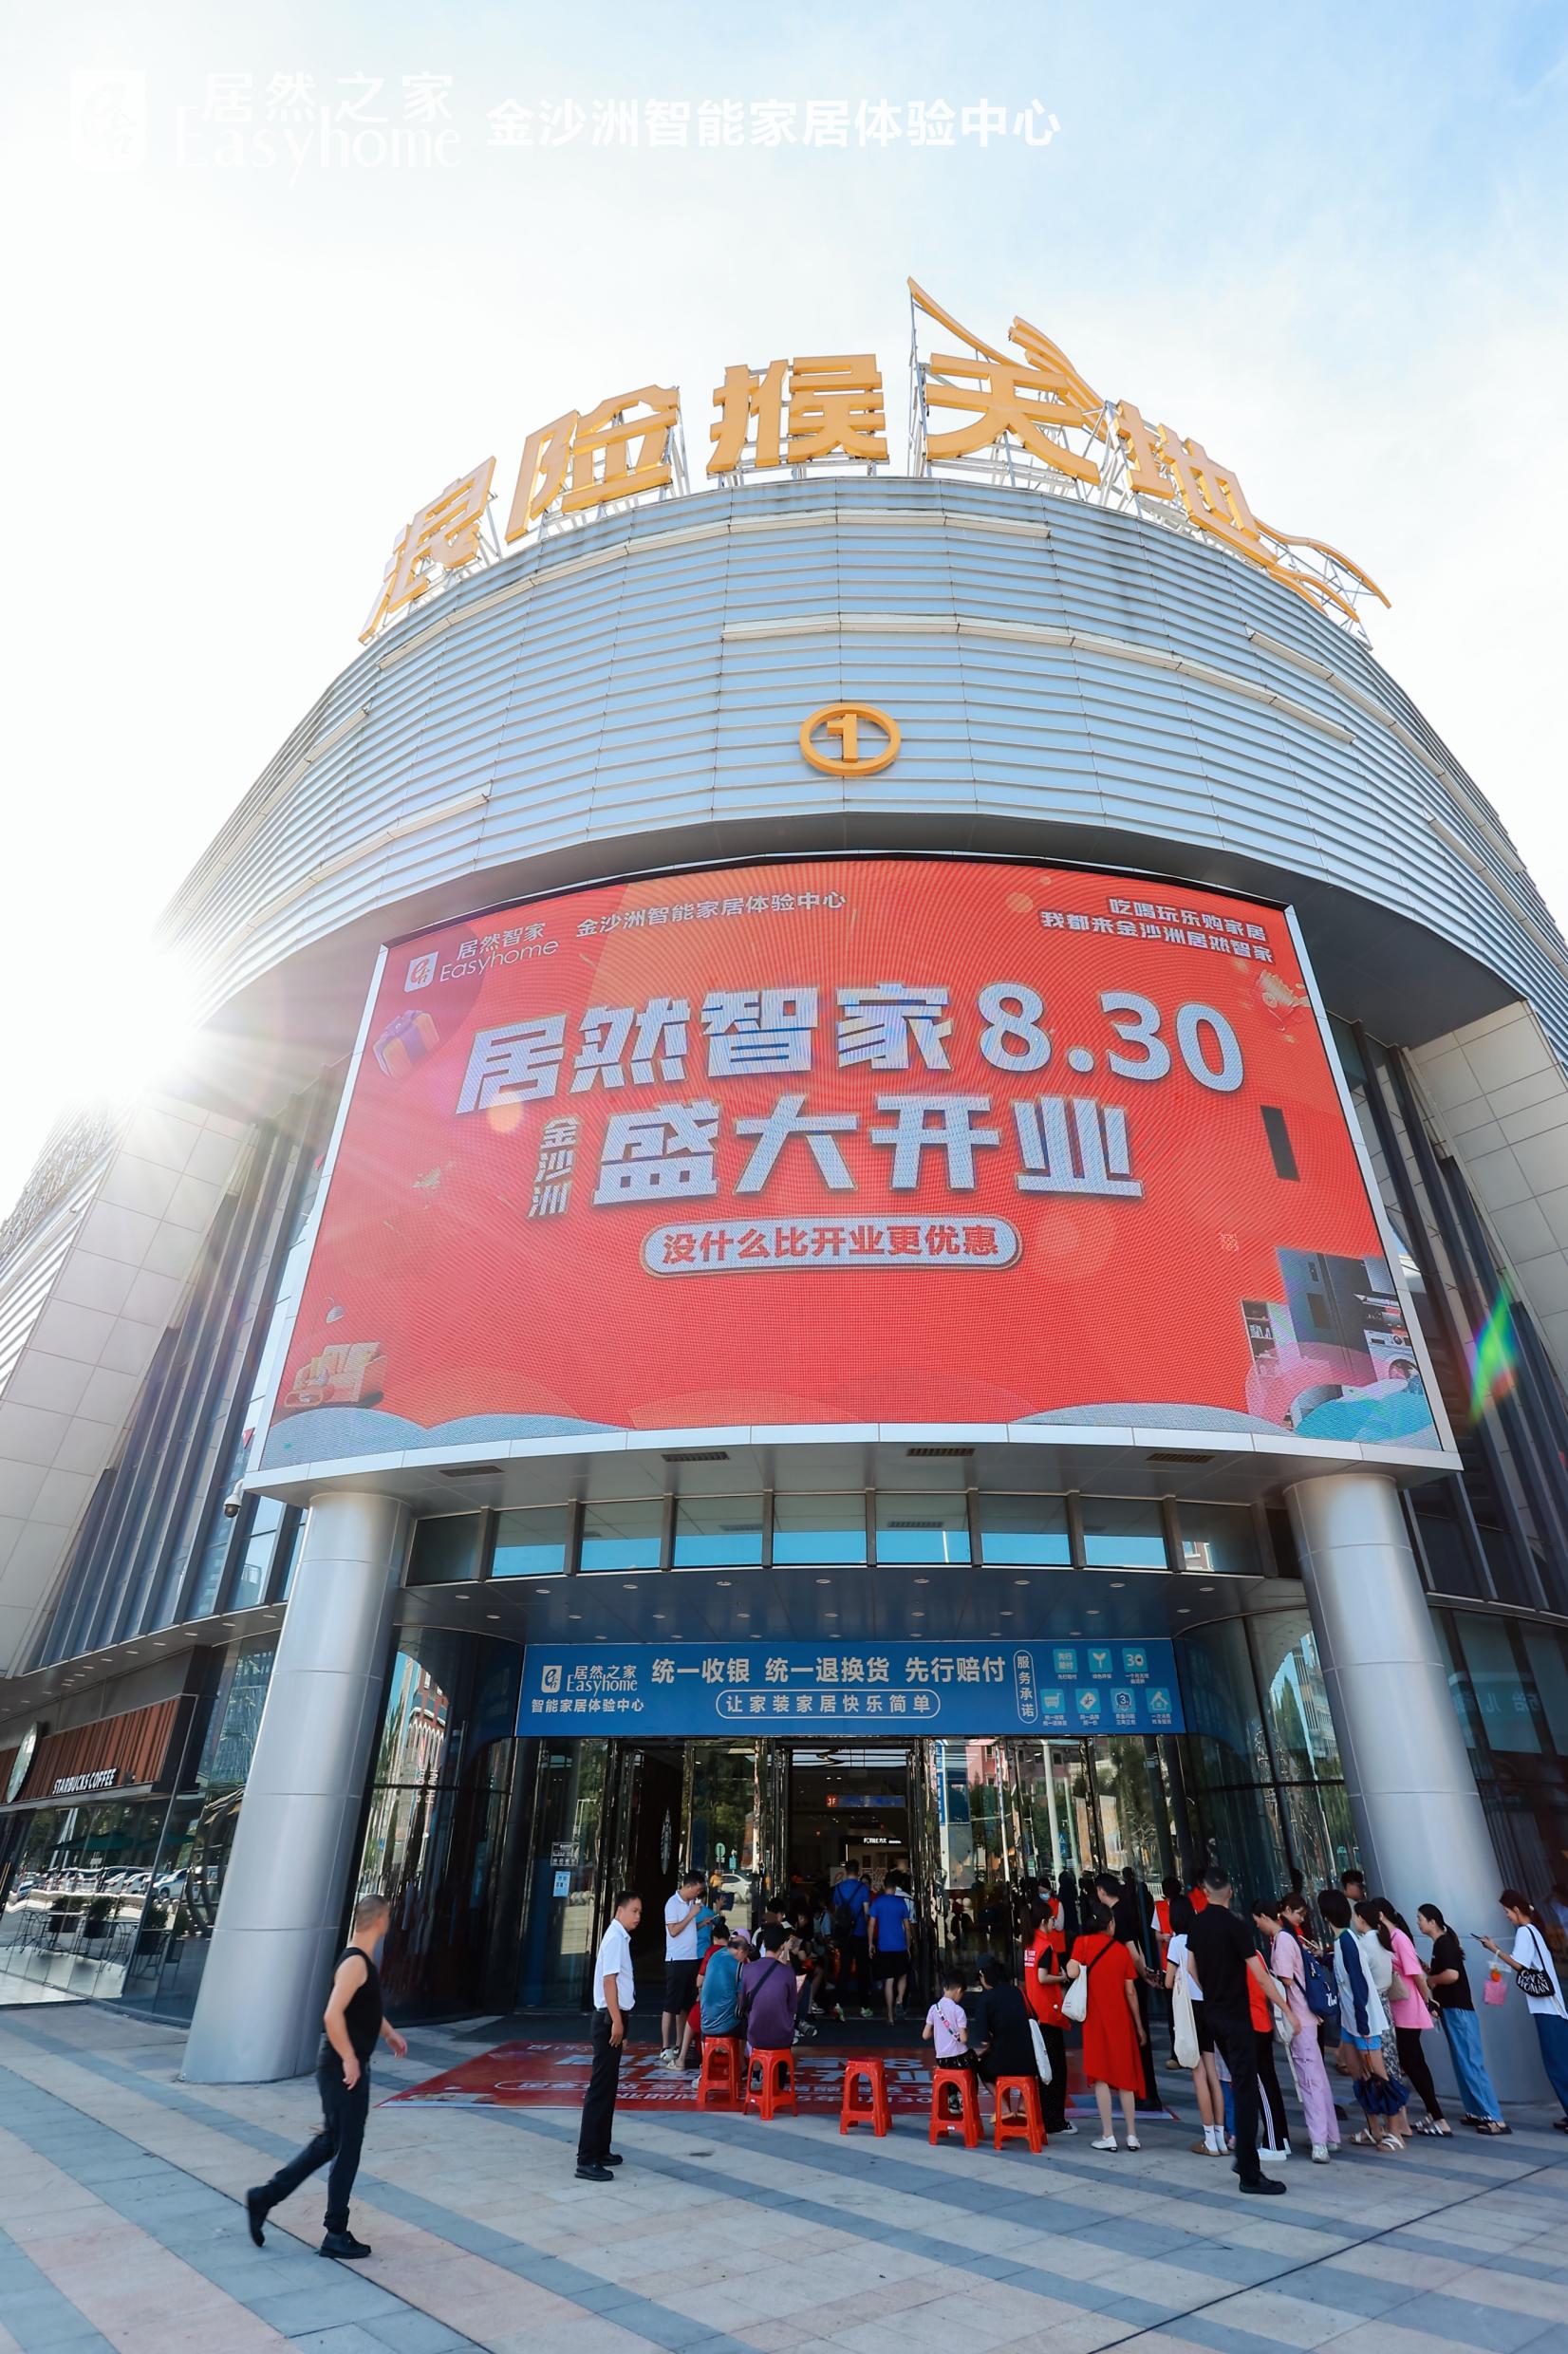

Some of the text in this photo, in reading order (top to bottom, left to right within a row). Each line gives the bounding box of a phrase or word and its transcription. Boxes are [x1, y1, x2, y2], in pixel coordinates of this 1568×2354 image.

[575, 890, 848, 939] 金沙洲智能家居体验中心
[1109, 898, 1267, 943] 吃喝玩乐购家居
[457, 922, 547, 961] 居然智家
[1040, 910, 1275, 963] 我都来金沙洲居然智家
[439, 941, 559, 982] Easyhome
[527, 1116, 581, 1220] 金沙洲
[592, 1093, 1145, 1207] 盛大开业
[663, 1224, 999, 1264] 没什么比开业更优惠
[567, 1674, 638, 1697] Easyhome
[573, 1665, 637, 1680] 居然之家
[651, 1656, 1006, 1684] 统一收银 统一退换货 先行赔付
[1017, 1655, 1035, 1717] 服务承诺
[532, 1698, 644, 1713] 智能家居体验中心
[726, 1694, 931, 1713] 让家装家居快乐简单
[52, 1768, 117, 1795] STARBUCKS COFFEE
